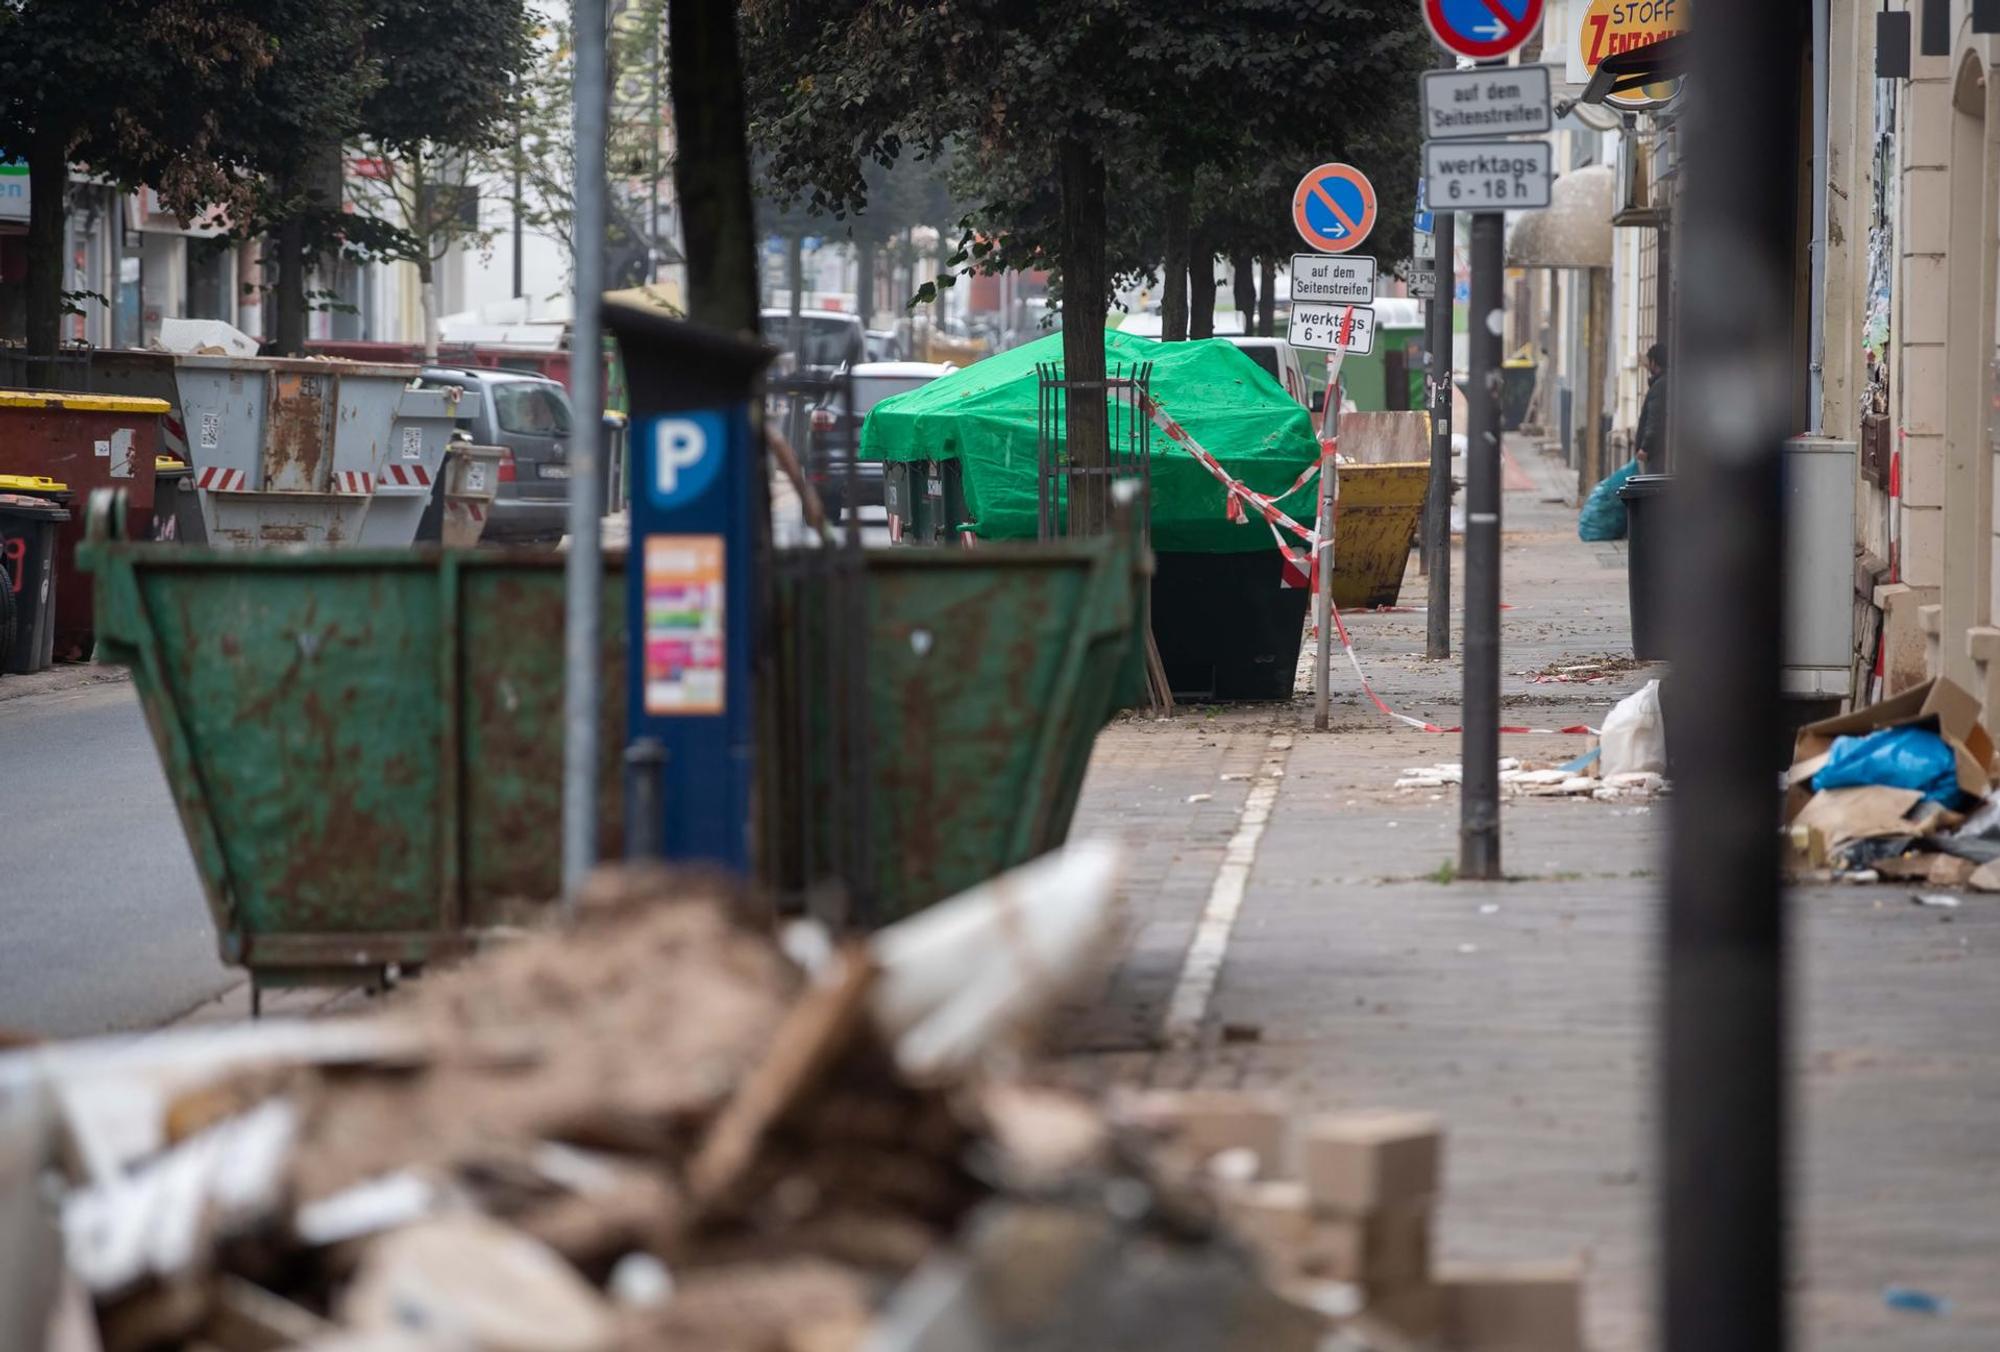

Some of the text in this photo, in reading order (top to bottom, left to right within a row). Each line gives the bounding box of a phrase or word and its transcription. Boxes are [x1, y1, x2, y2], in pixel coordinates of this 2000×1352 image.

[1613, 0, 1676, 24] STOFF
[1454, 82, 1521, 102] auf dem
[1434, 104, 1543, 128] Seitenstreifen
[1438, 154, 1538, 179] werktags
[1448, 179, 1461, 199] 6
[1483, 179, 1507, 199] 18
[1514, 177, 1528, 198] h
[1311, 265, 1355, 279] auf dem
[1410, 274, 1417, 284] 2
[1297, 280, 1369, 296] Seitenstreifen
[1304, 327, 1313, 341] 6
[655, 418, 707, 495] P
